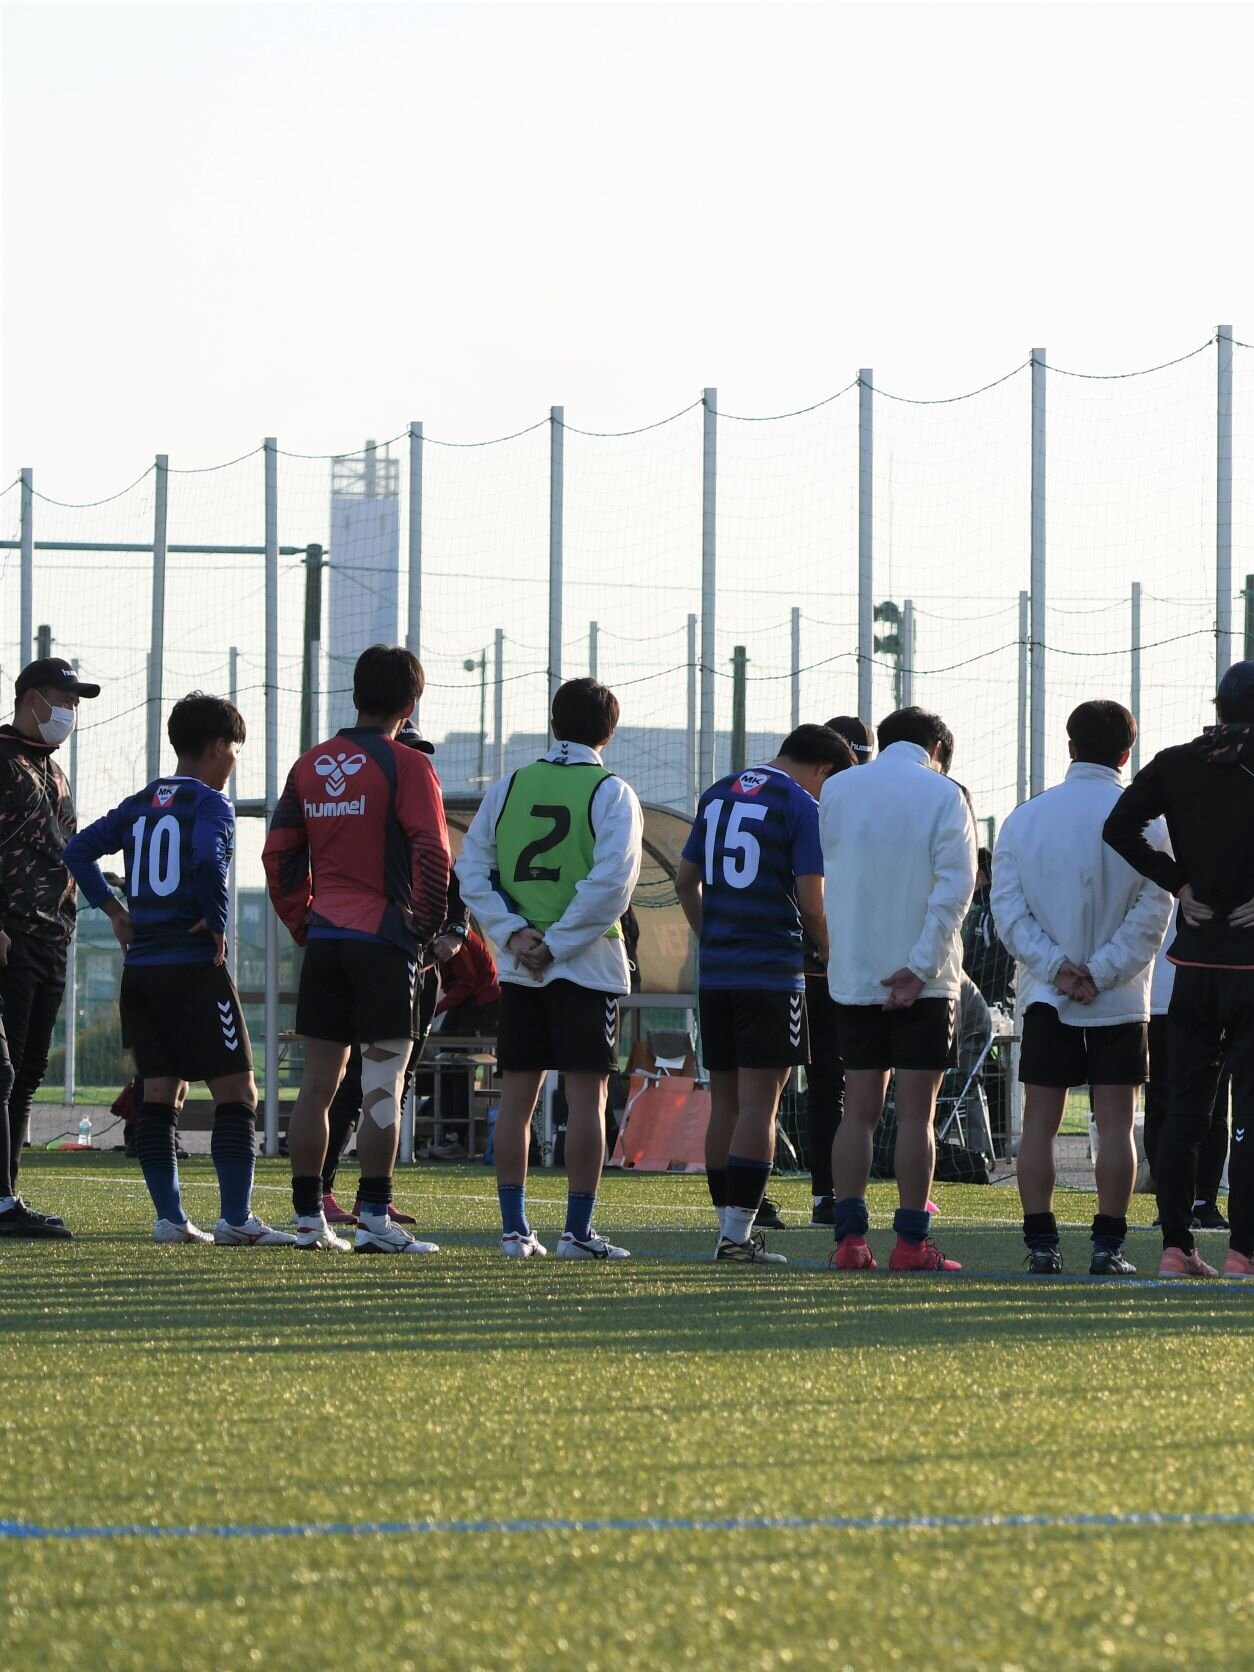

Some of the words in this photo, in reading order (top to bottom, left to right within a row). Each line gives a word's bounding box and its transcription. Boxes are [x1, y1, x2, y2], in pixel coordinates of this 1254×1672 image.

[158, 788, 176, 796] MK
[741, 775, 764, 785] MK
[304, 795, 366, 818] hummel
[131, 814, 181, 897] 10
[513, 804, 571, 882] 2
[703, 798, 769, 889] 15
